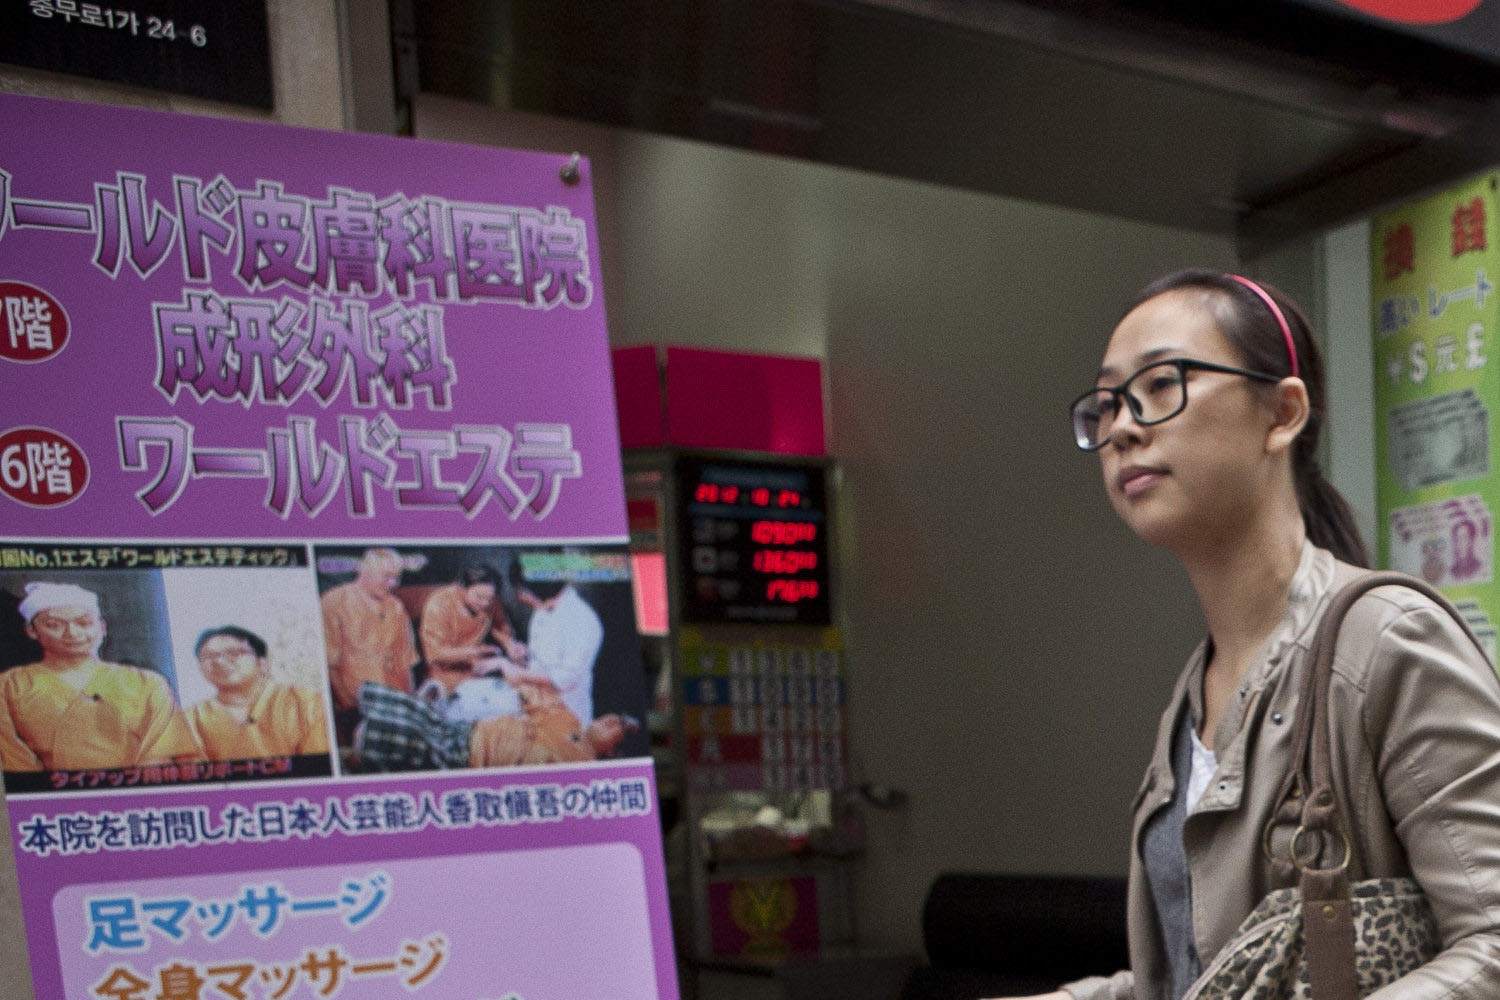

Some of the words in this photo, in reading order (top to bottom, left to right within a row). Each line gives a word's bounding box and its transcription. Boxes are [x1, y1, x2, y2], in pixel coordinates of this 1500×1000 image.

[0, 169, 592, 309] ールド皮膚科医院
[0, 295, 53, 350] 階
[152, 288, 456, 411] 成形外科
[1, 441, 73, 495] 6階
[115, 415, 581, 521] ワールドエステ
[87, 876, 388, 950] 足マッサージ
